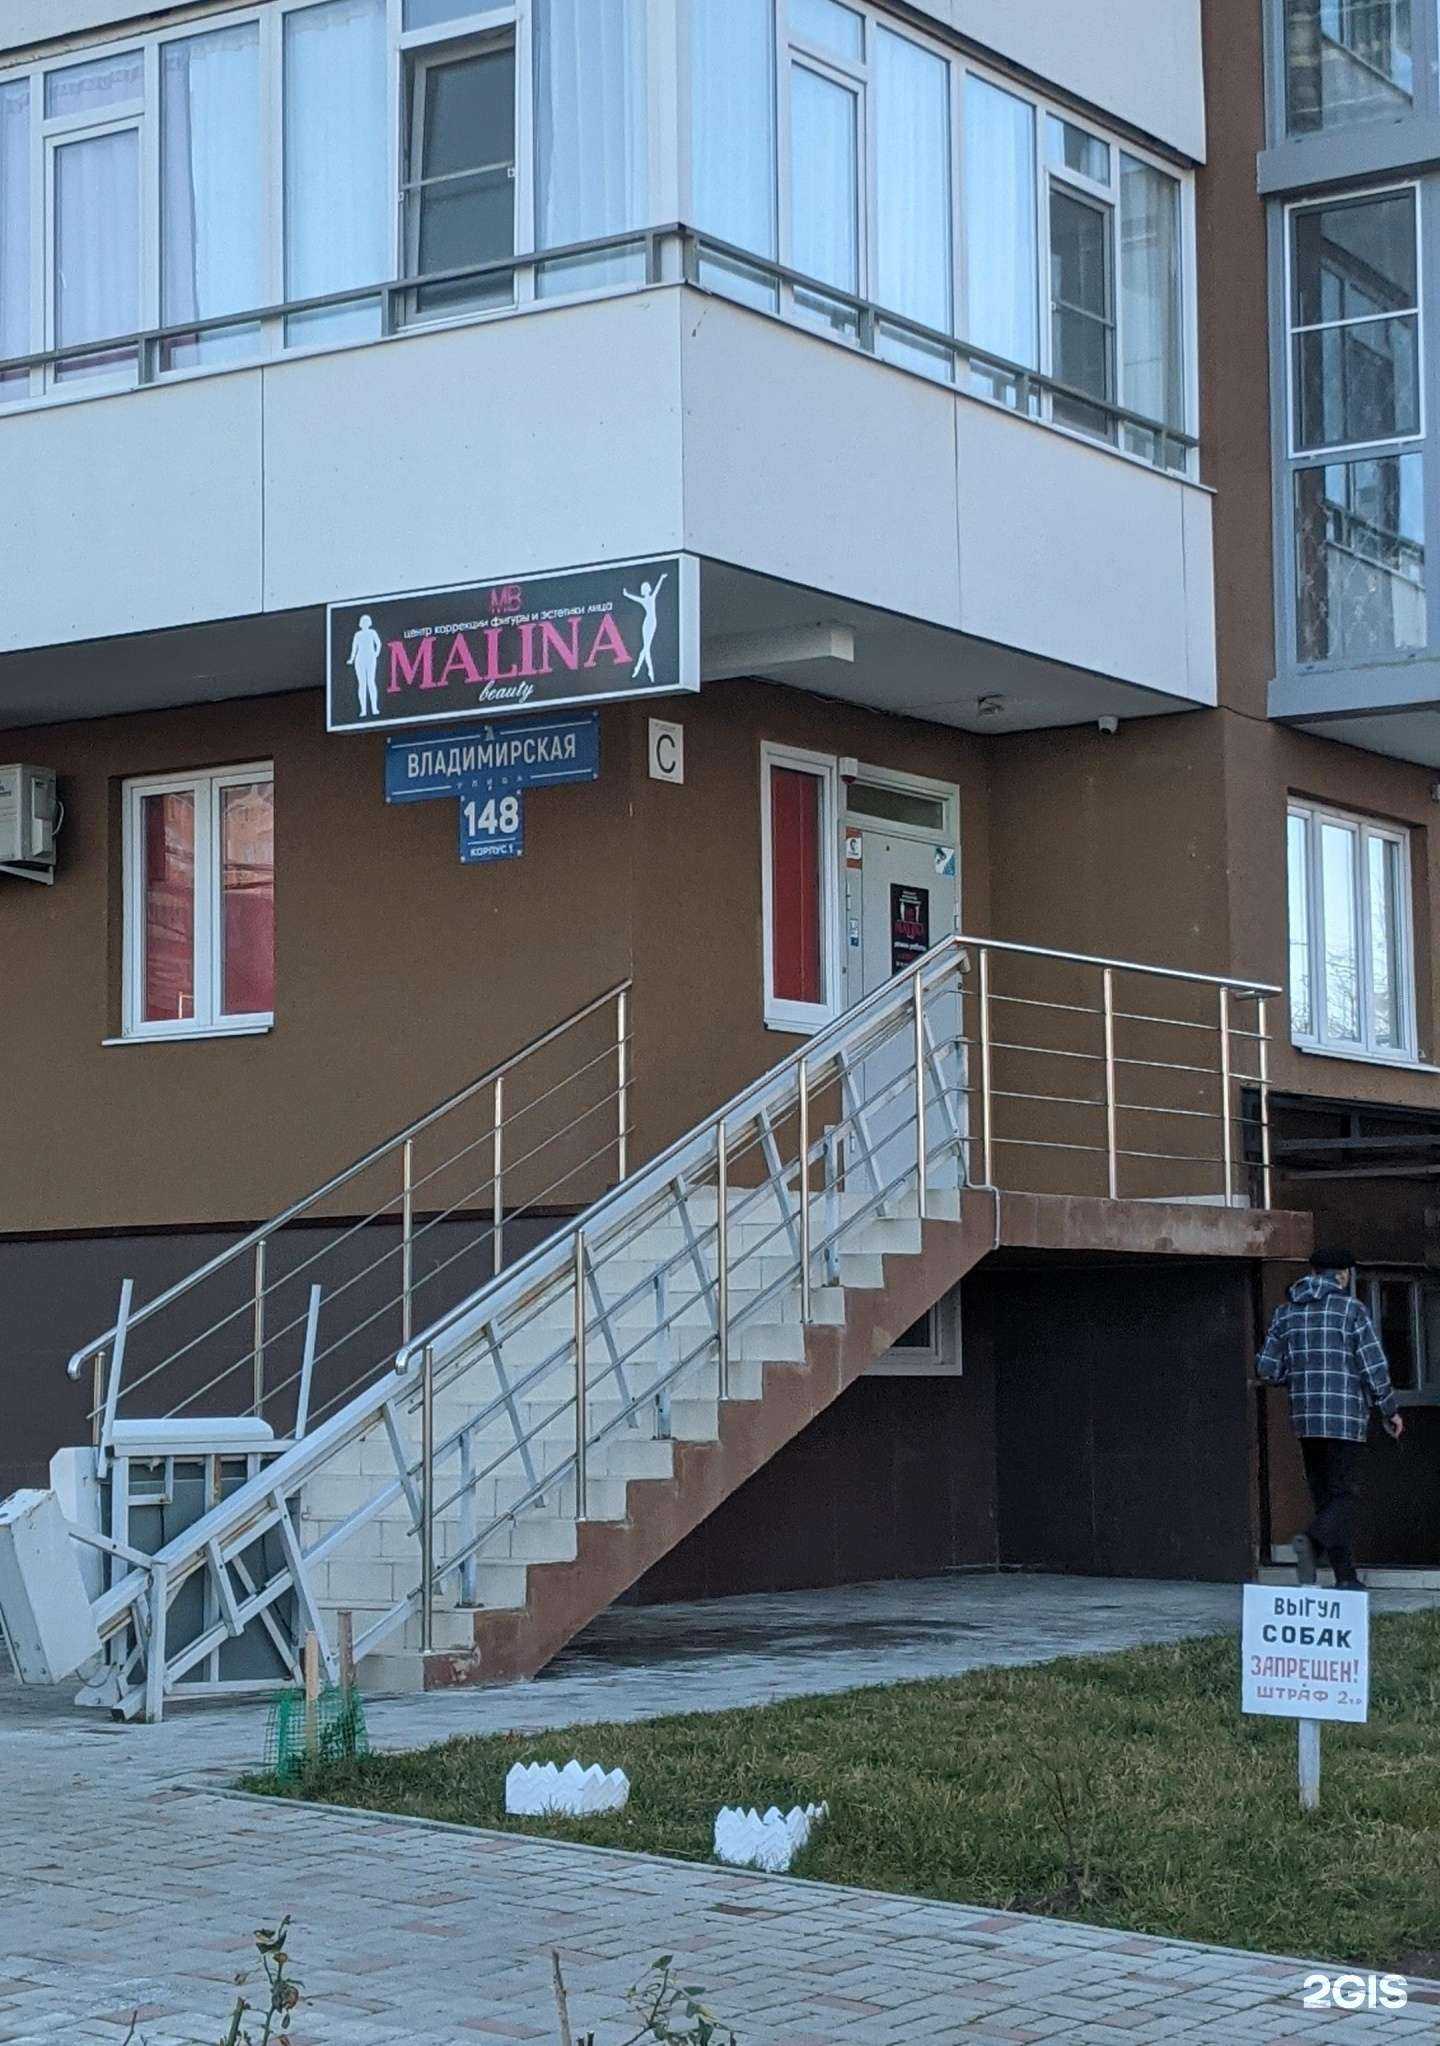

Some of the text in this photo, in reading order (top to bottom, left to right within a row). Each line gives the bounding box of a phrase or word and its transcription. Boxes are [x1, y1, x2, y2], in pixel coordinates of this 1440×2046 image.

[531, 612, 539, 621] и
[386, 613, 632, 693] MALINA
[478, 680, 535, 703] beauty
[407, 733, 576, 777] ВЛАДИМИРСКАЯ
[463, 796, 519, 837] 148
[470, 843, 514, 856] КОРПУС 1
[1274, 1597, 1341, 1619] ВЫГУЛ
[1262, 1624, 1353, 1649] СОБАК
[1251, 1654, 1359, 1684] ЗАПРЕЩЕН!
[1257, 1685, 1329, 1702] ШТРАФ
